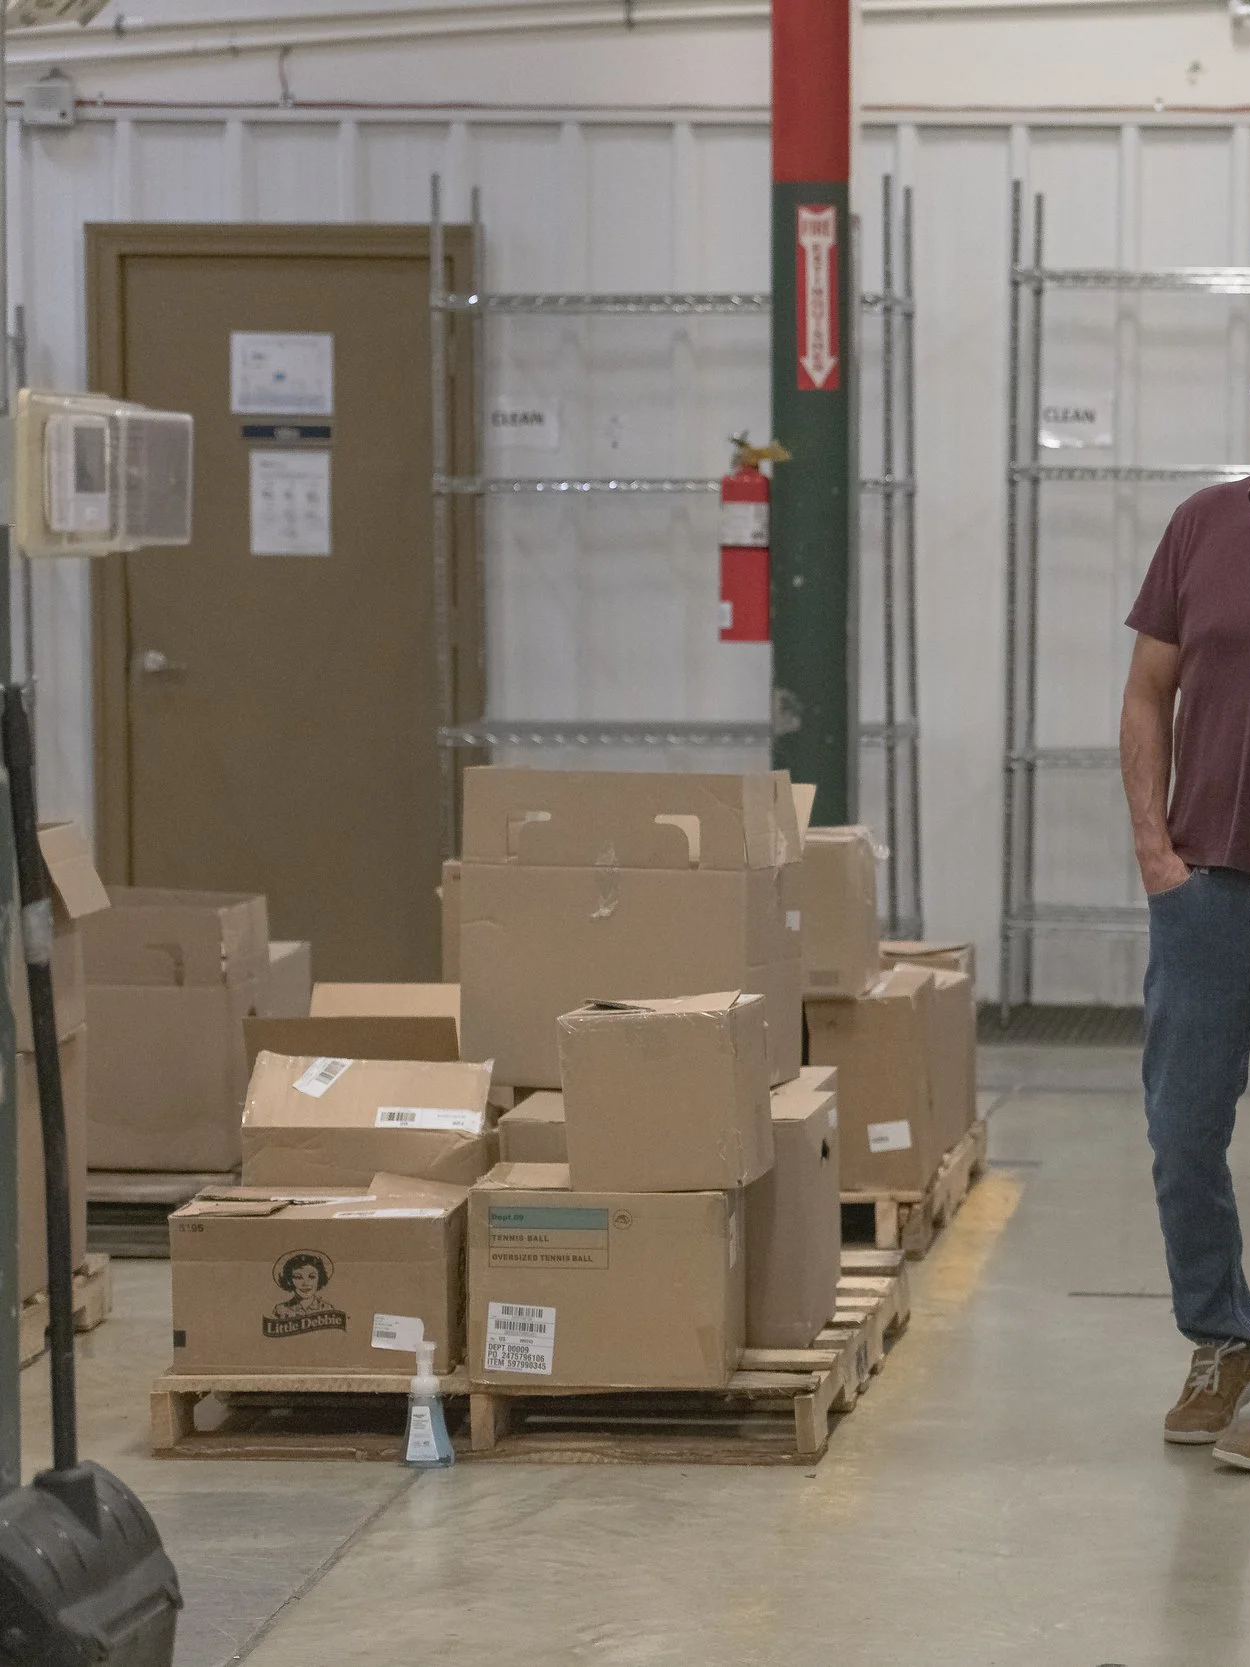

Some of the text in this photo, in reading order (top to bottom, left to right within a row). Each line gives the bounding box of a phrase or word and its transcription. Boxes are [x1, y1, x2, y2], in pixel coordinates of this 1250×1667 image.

[491, 411, 545, 427] CLEAN
[1043, 406, 1097, 424] CLEAN
[492, 1234, 524, 1242] TENNIS
[492, 1253, 538, 1261] OVERSIZED
[540, 1254, 570, 1262] TENNIS
[267, 1314, 343, 1334] Little Debbie
[488, 1343, 530, 1354] DEPT 00009
[487, 1358, 505, 1366] ITEM
